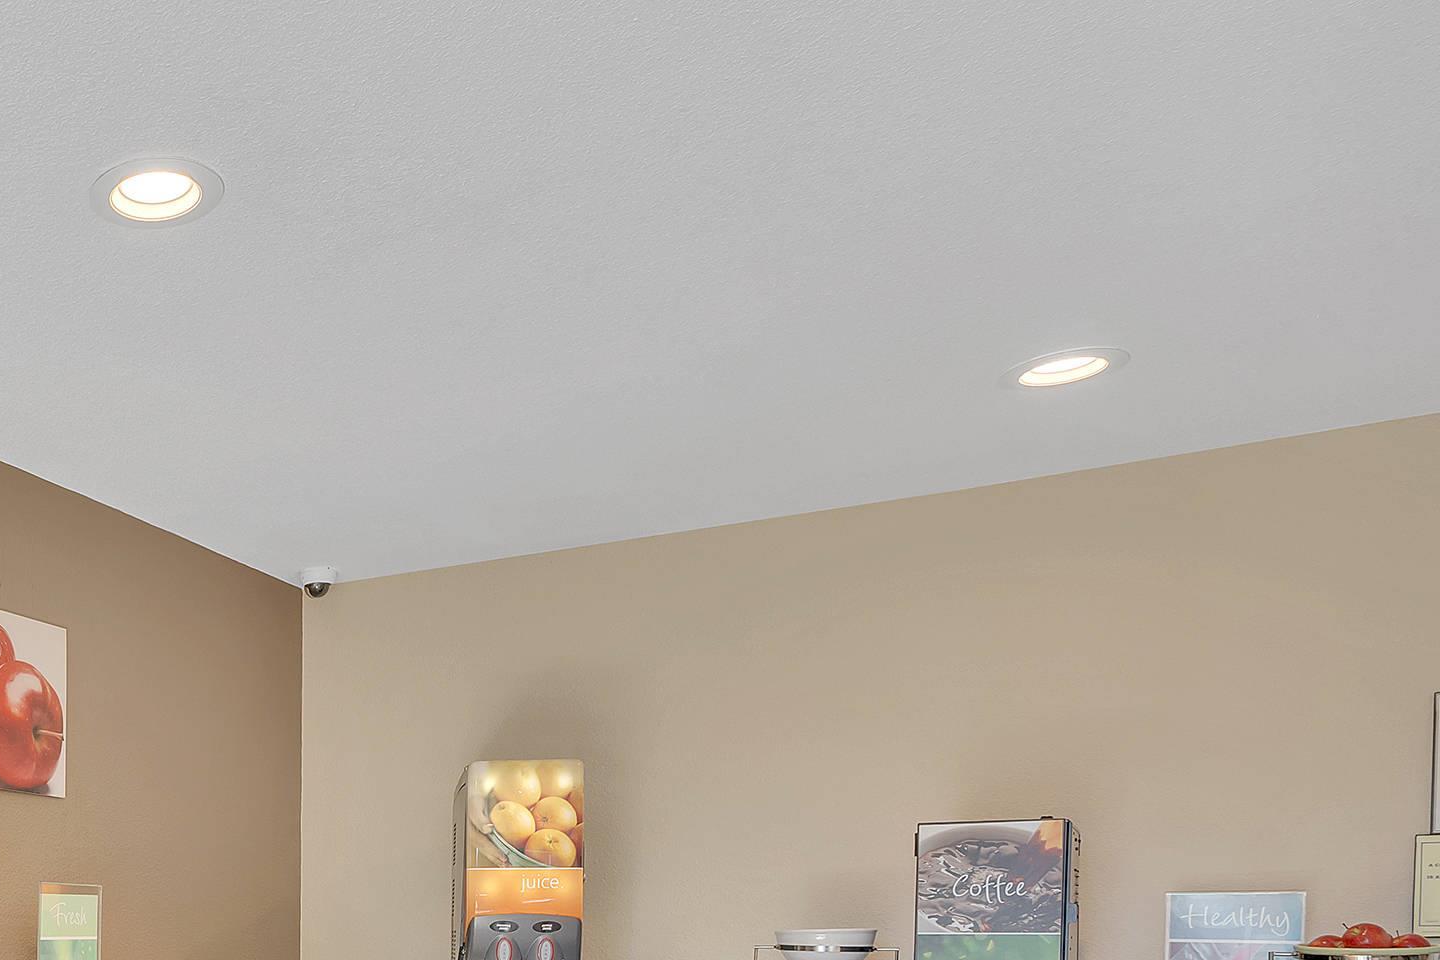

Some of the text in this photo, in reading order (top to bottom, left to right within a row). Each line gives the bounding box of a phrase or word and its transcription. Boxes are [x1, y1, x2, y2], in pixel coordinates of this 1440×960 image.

[952, 874, 1028, 904] Coffee
[48, 902, 88, 928] Fresh
[1179, 903, 1290, 937] Healthy
